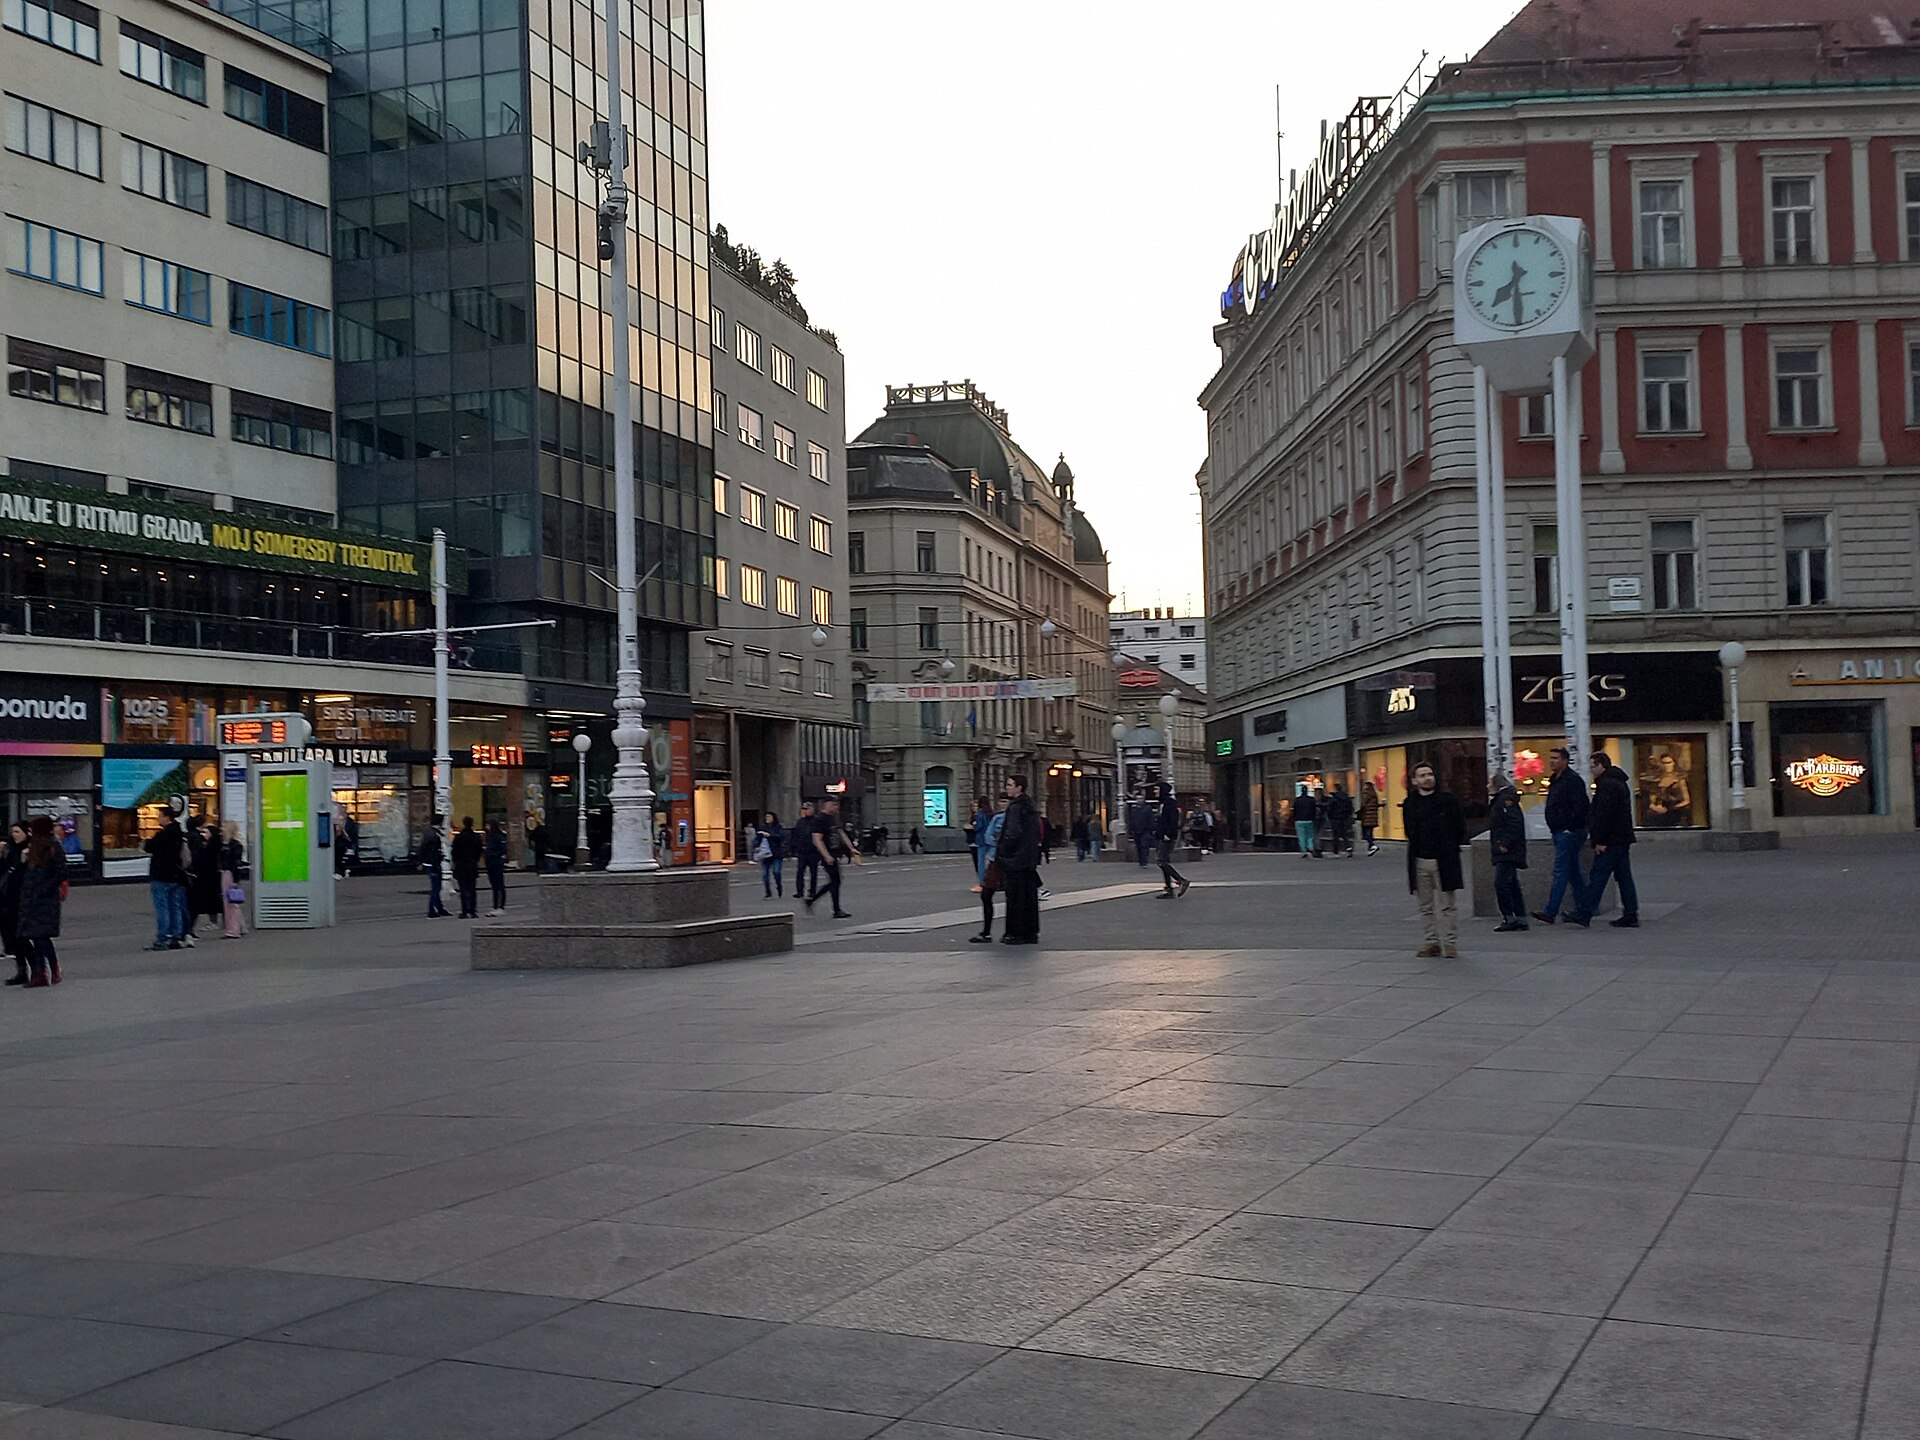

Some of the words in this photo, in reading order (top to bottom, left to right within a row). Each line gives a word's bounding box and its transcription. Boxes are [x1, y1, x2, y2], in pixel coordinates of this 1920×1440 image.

[57, 501, 71, 527] U
[76, 505, 138, 536] RITMU
[143, 515, 209, 547] GRADA.
[213, 524, 250, 552] MOJ
[254, 531, 336, 564] SOMERSBY
[340, 543, 418, 576] TRENUTAK.
[340, 749, 388, 767] LJEVAK
[1789, 762, 1805, 782] LA
